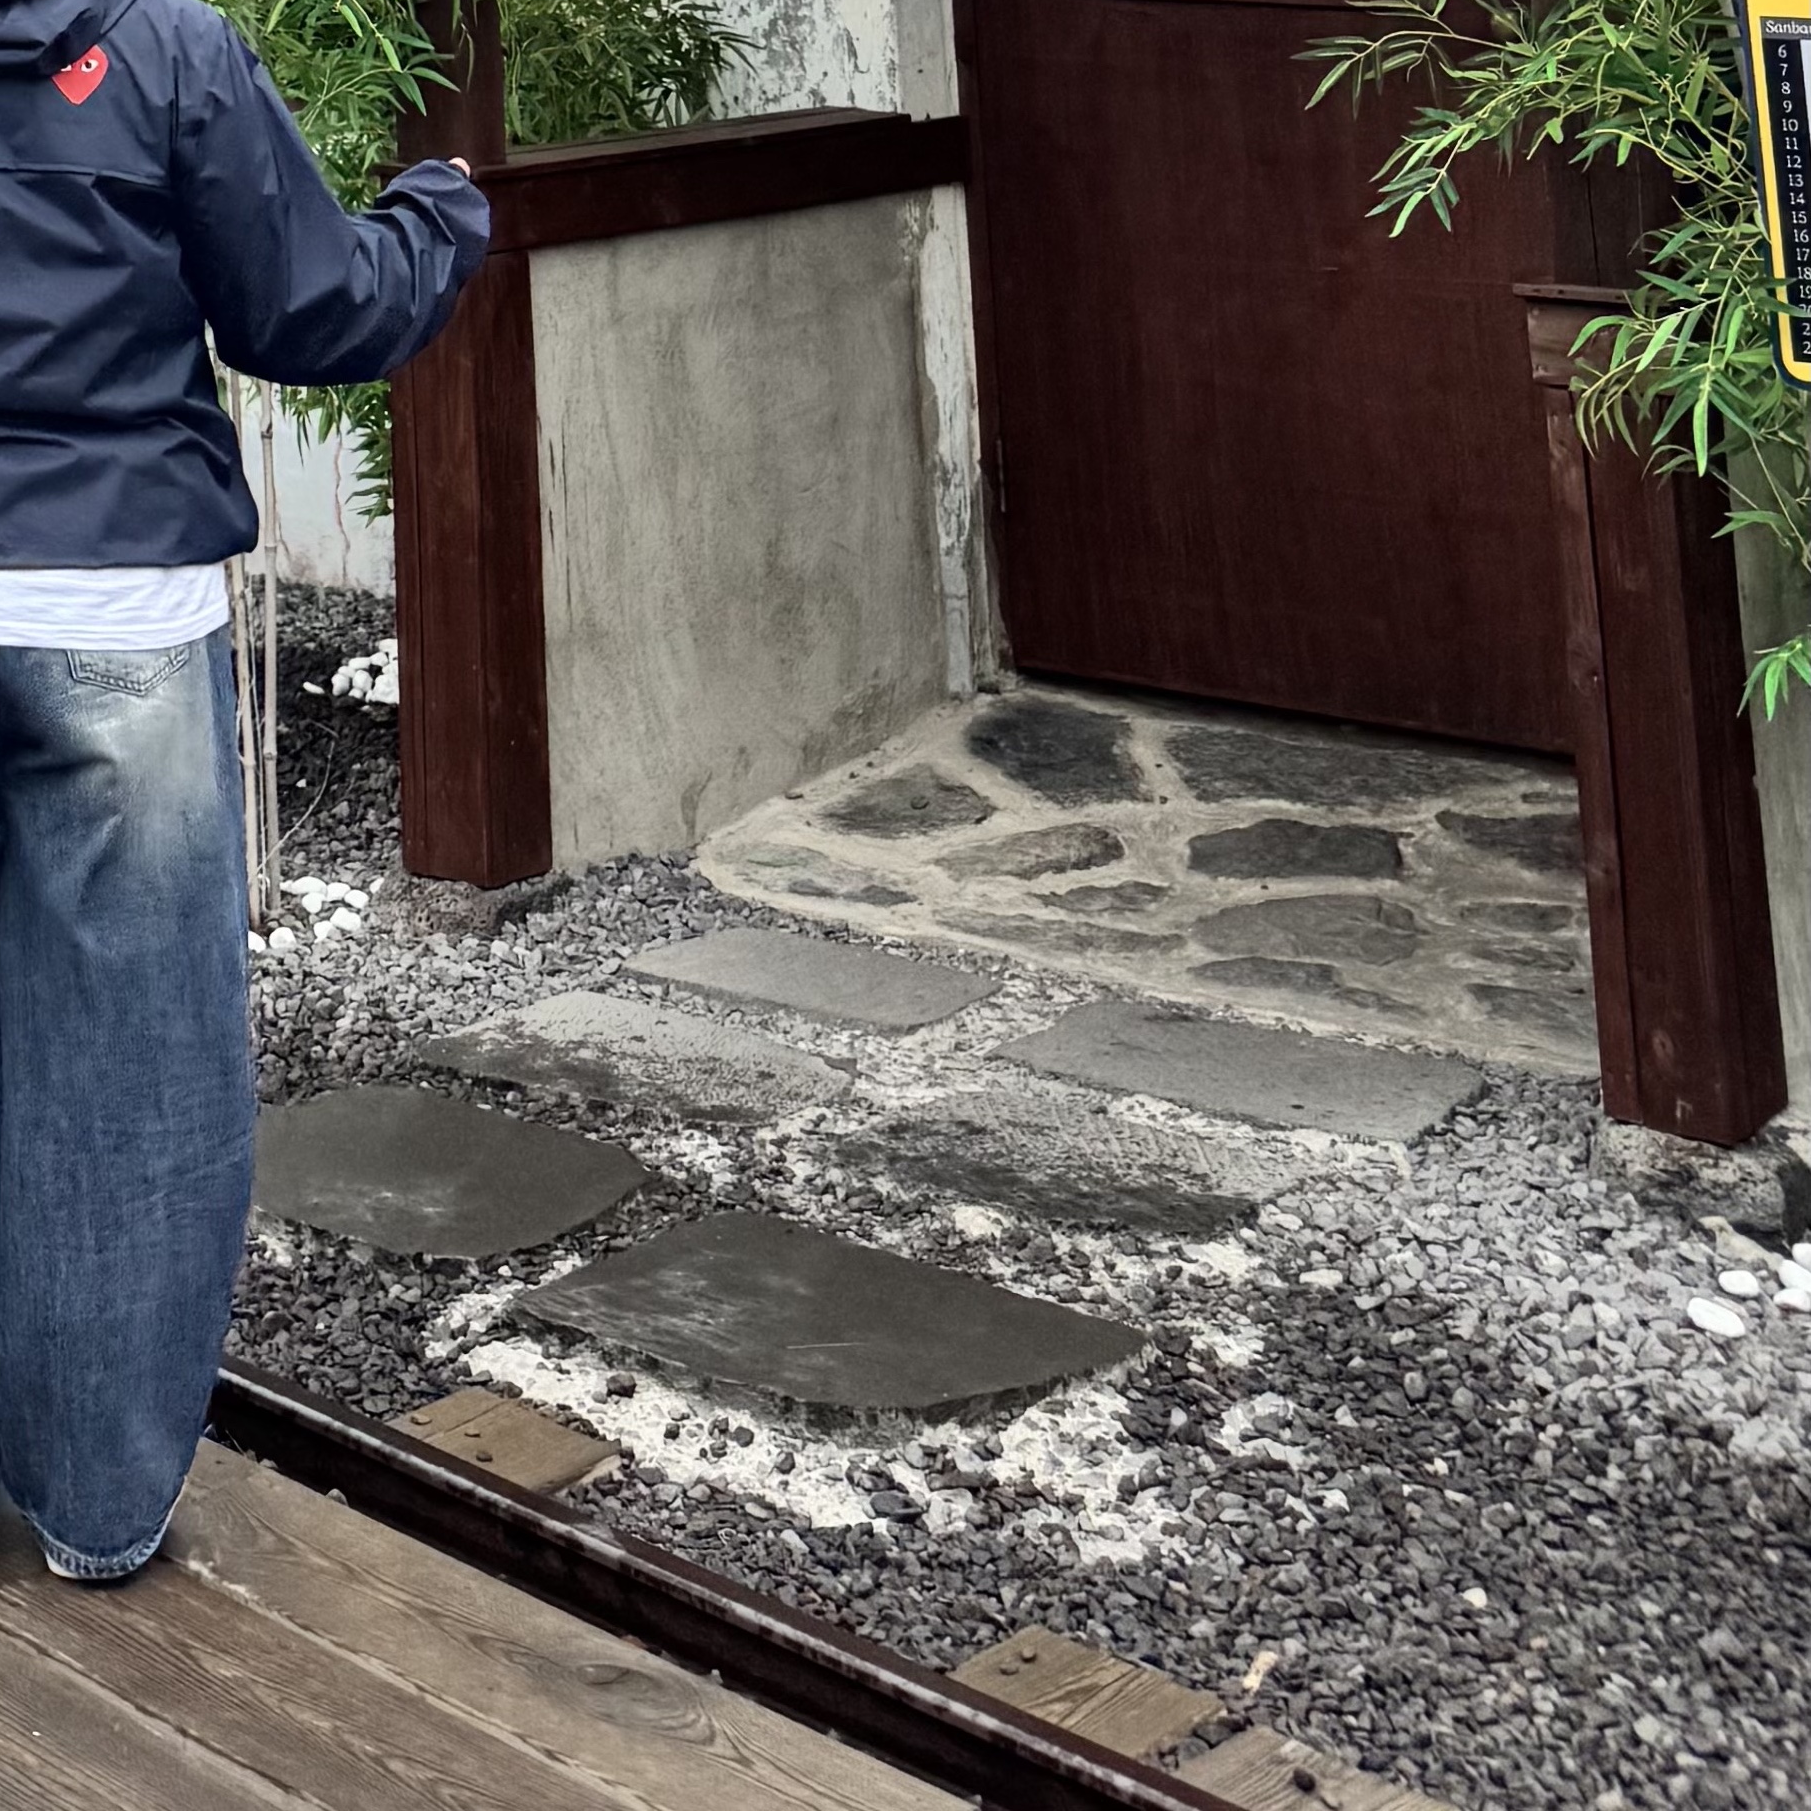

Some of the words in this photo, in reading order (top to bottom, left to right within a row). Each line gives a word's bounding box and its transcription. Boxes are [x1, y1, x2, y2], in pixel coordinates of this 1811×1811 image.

[1765, 20, 1811, 34] Sanba
[1778, 44, 1787, 58] 6
[1780, 63, 1788, 76] 7
[1781, 81, 1791, 95] 8
[1783, 100, 1792, 113] 9
[1782, 118, 1798, 131] 10
[1785, 137, 1798, 150] 11
[1786, 155, 1802, 168] 12
[1788, 174, 1804, 187] 13
[1790, 192, 1805, 205] 14
[1791, 211, 1807, 224] 15
[1794, 229, 1809, 243] 16
[1796, 248, 1810, 261] 17
[1797, 266, 1811, 280] 18
